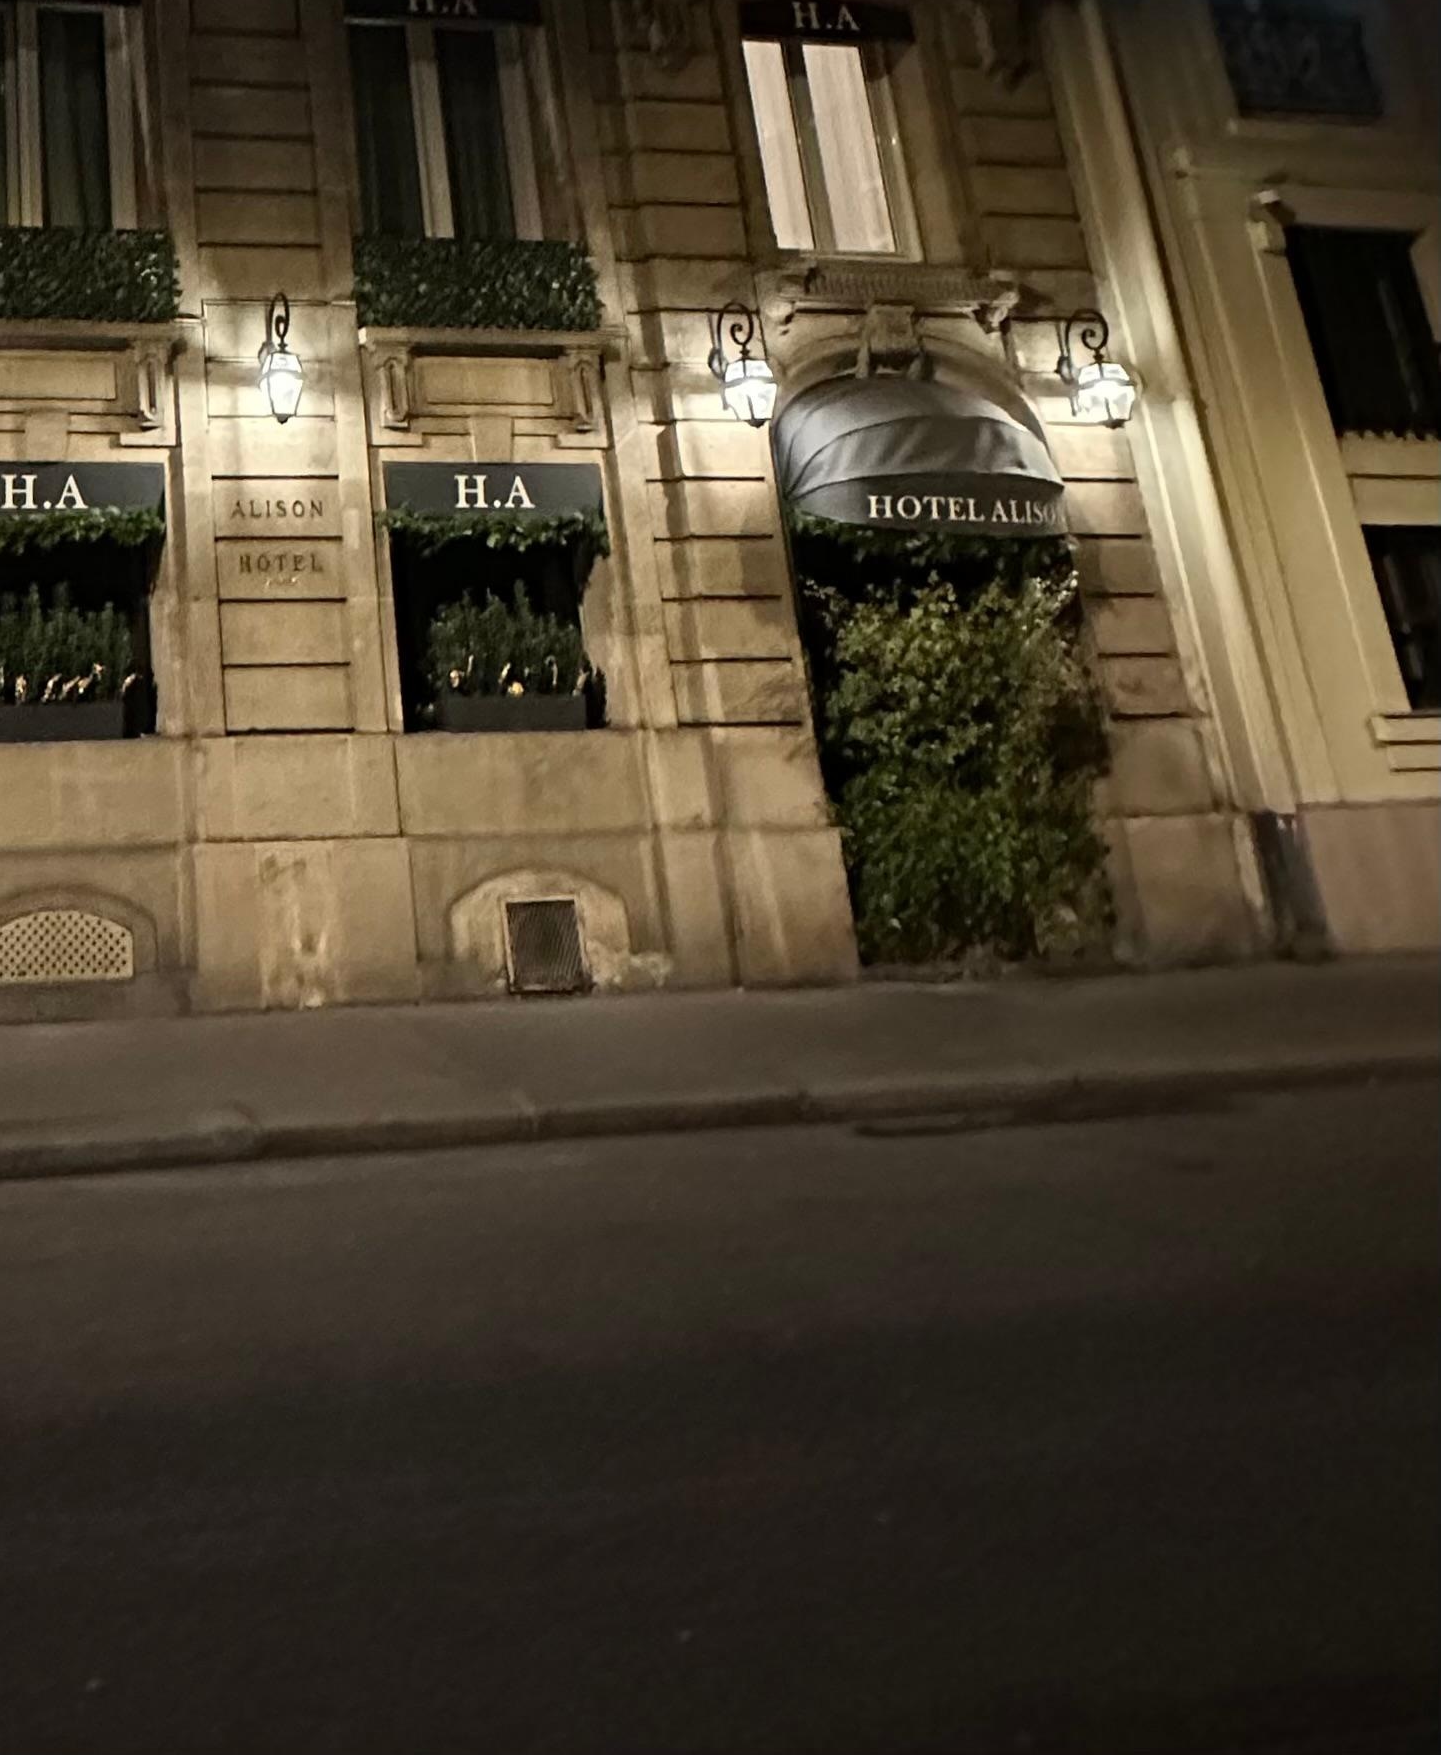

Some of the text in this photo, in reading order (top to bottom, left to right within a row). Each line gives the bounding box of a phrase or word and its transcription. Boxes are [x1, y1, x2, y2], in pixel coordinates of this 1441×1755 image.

[790, 0, 861, 31] H.A
[0, 474, 89, 510] H.A
[454, 474, 536, 509] H.A
[230, 500, 324, 520] ALISON
[868, 496, 985, 522] HOTEL
[239, 552, 324, 574] HOTEL
